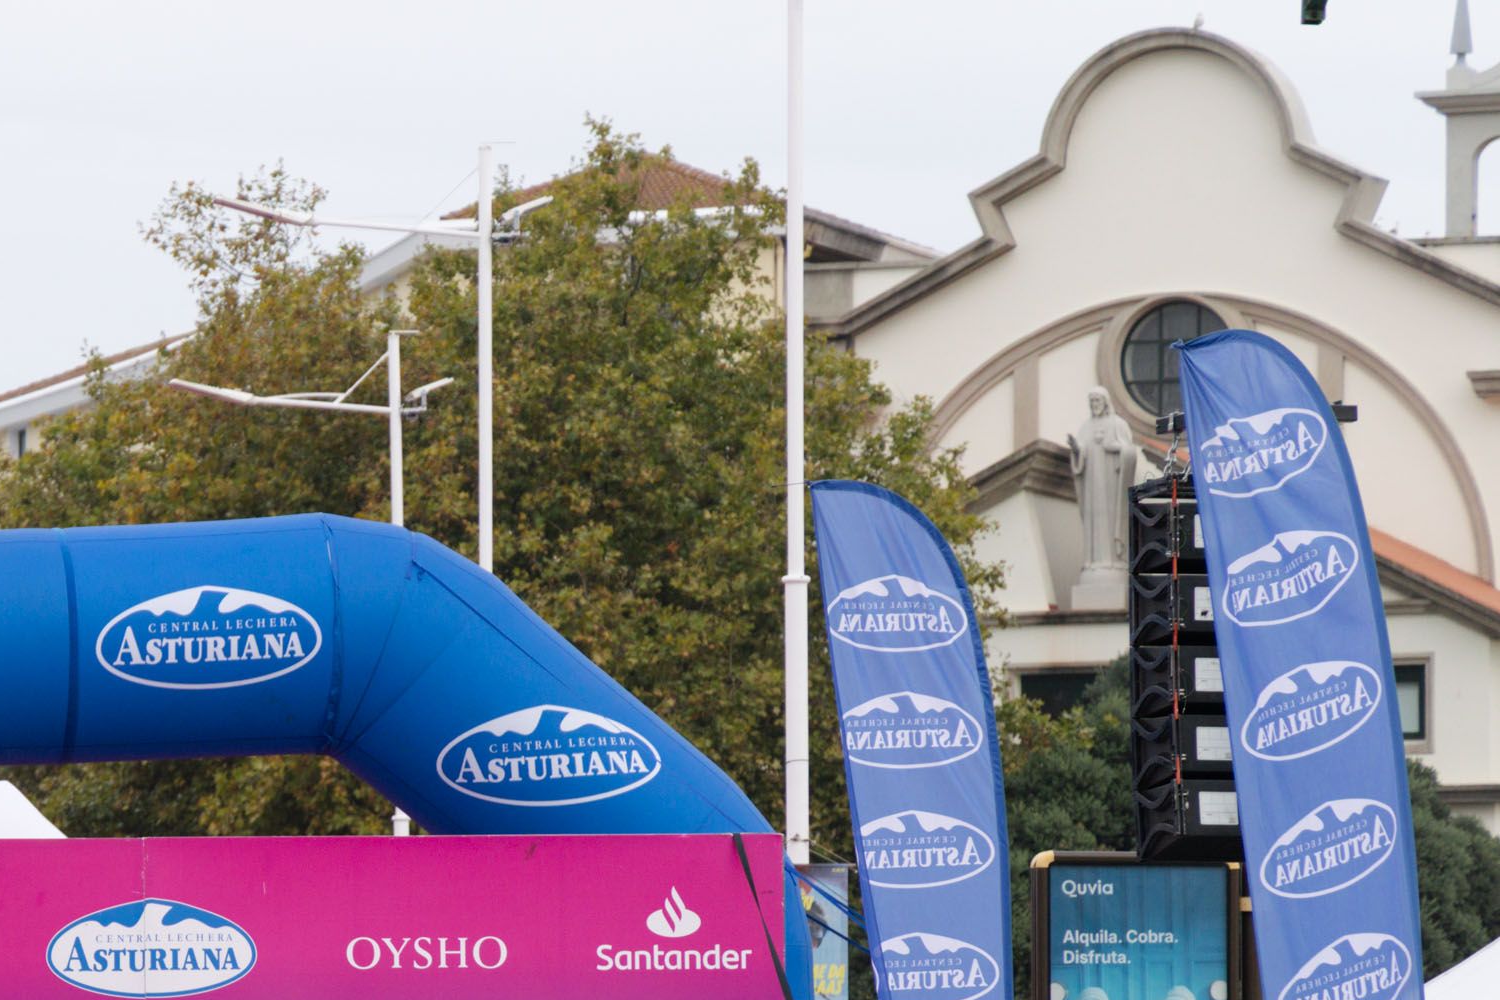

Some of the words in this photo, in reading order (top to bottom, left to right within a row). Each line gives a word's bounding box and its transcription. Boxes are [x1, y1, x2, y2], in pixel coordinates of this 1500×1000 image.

[148, 619, 219, 634] CENTRAL
[225, 617, 297, 631] LECHERA
[113, 626, 305, 665] ASTURIANA
[489, 739, 560, 753] CENTRAL
[567, 736, 636, 751] LECHERA
[455, 747, 648, 784] ASTURIANA
[1061, 880, 1114, 898] Quvia
[95, 932, 160, 943] CENTRAL
[168, 932, 233, 942] LECHERA
[1063, 929, 1122, 946] Alquila.
[1126, 929, 1179, 944] Cobra.
[64, 935, 240, 973] ASTURIANA
[346, 936, 507, 970] OYSHO
[596, 943, 752, 972] Santander
[1063, 950, 1131, 965] Disfruta.
